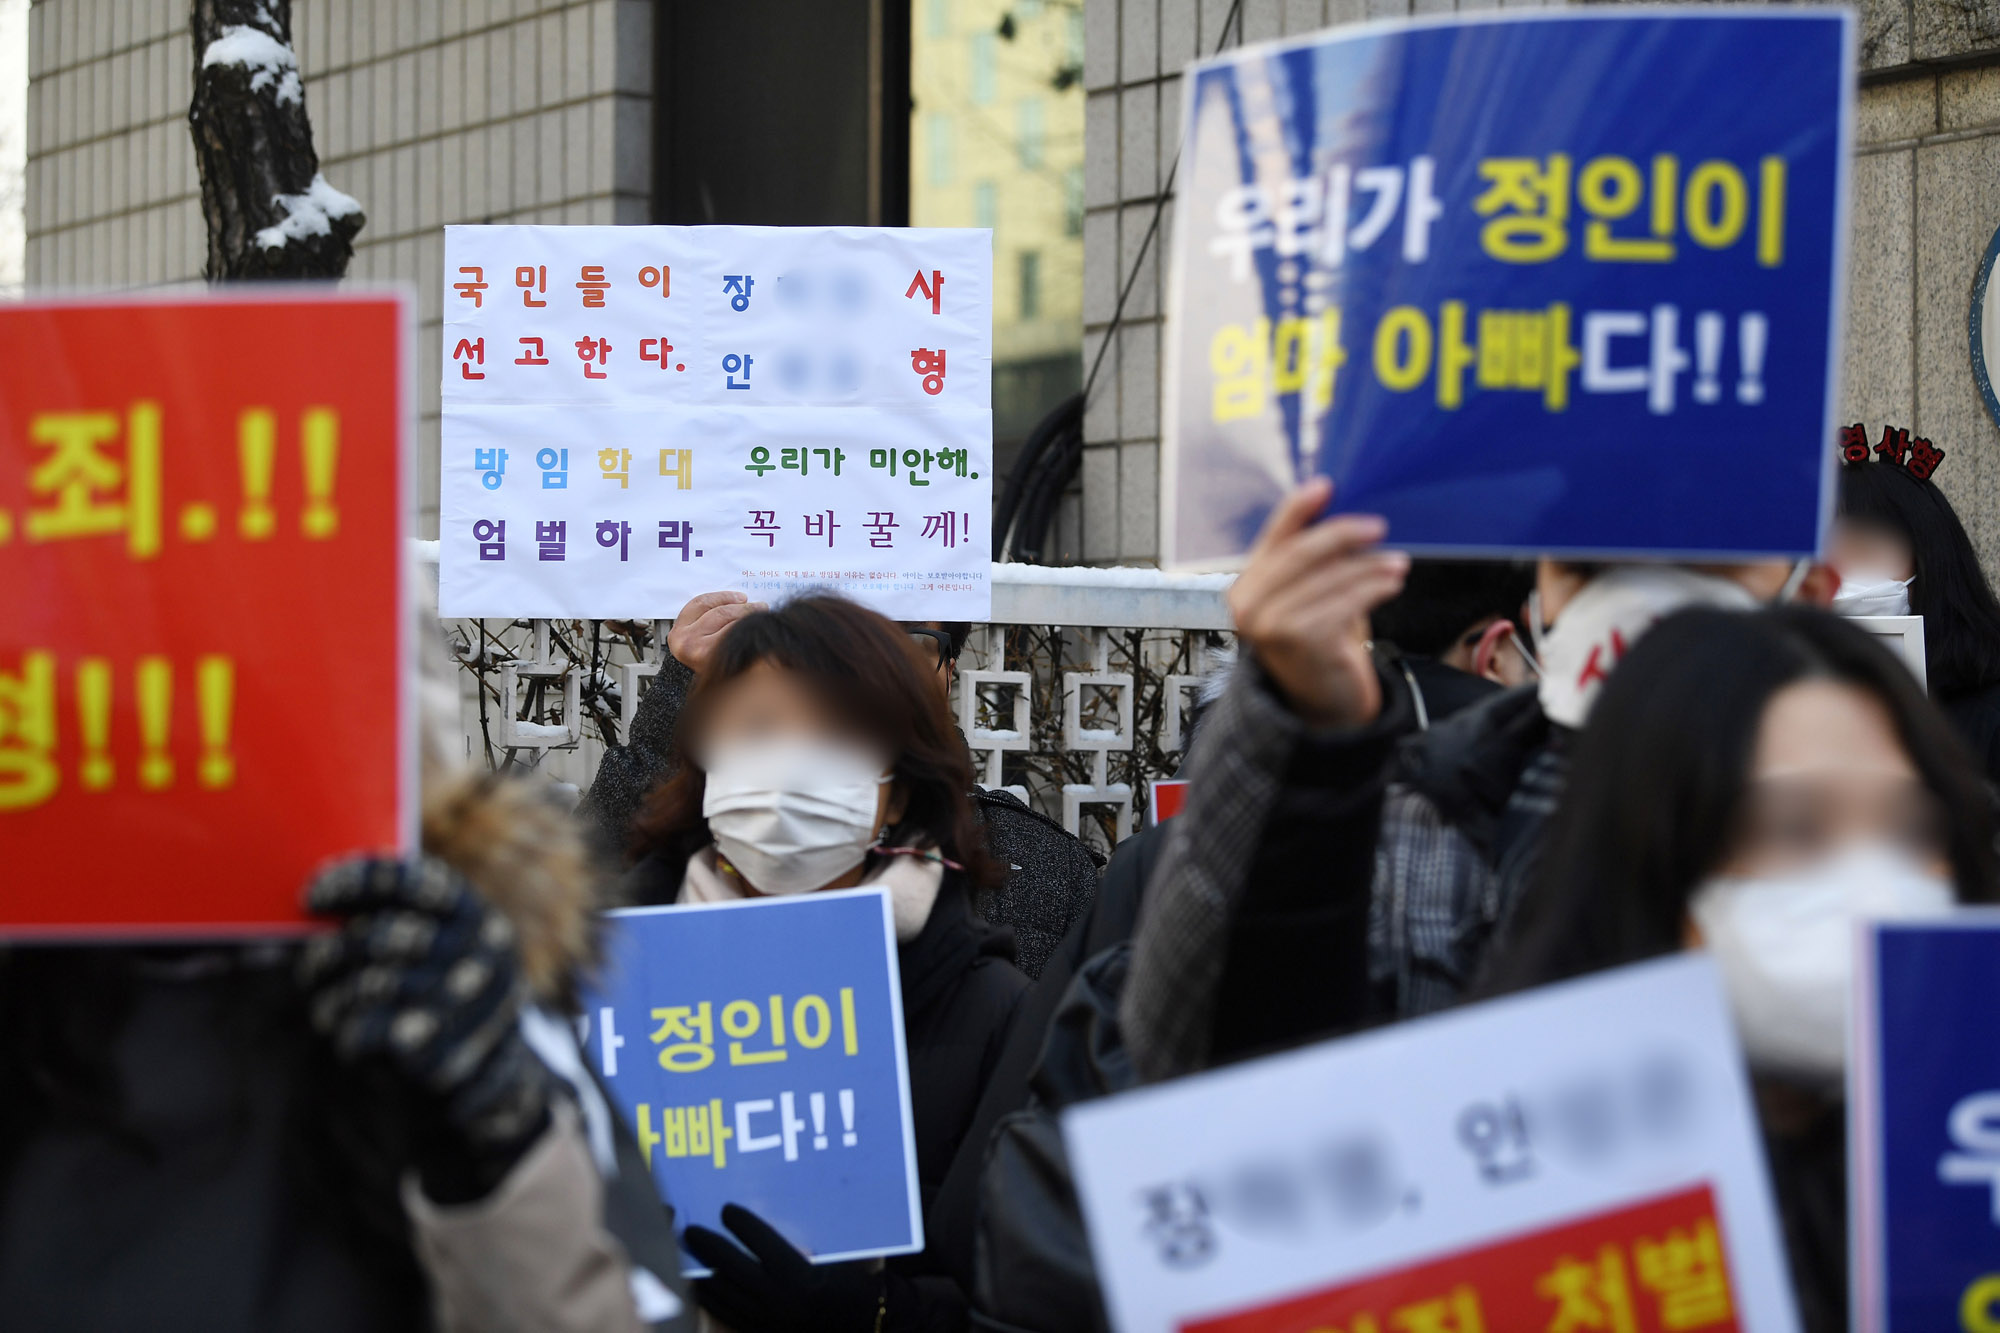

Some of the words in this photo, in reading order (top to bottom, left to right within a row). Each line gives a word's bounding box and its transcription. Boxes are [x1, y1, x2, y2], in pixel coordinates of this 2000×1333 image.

[1208, 154, 1443, 283] 우리가
[1472, 151, 1786, 269] 정인이
[1209, 303, 1347, 424] 엄마
[1371, 300, 1769, 415] 아빠다!!
[744, 446, 846, 478] 우리가
[869, 446, 979, 487] 미안해.
[743, 510, 782, 549] 꼭
[741, 570, 757, 578] 어느
[759, 570, 781, 578] 아이도
[784, 570, 799, 578] 학대
[844, 571, 866, 579] 이유는
[902, 571, 923, 580] 아이는
[919, 583, 934, 591] 그게
[649, 987, 859, 1073] 정인이
